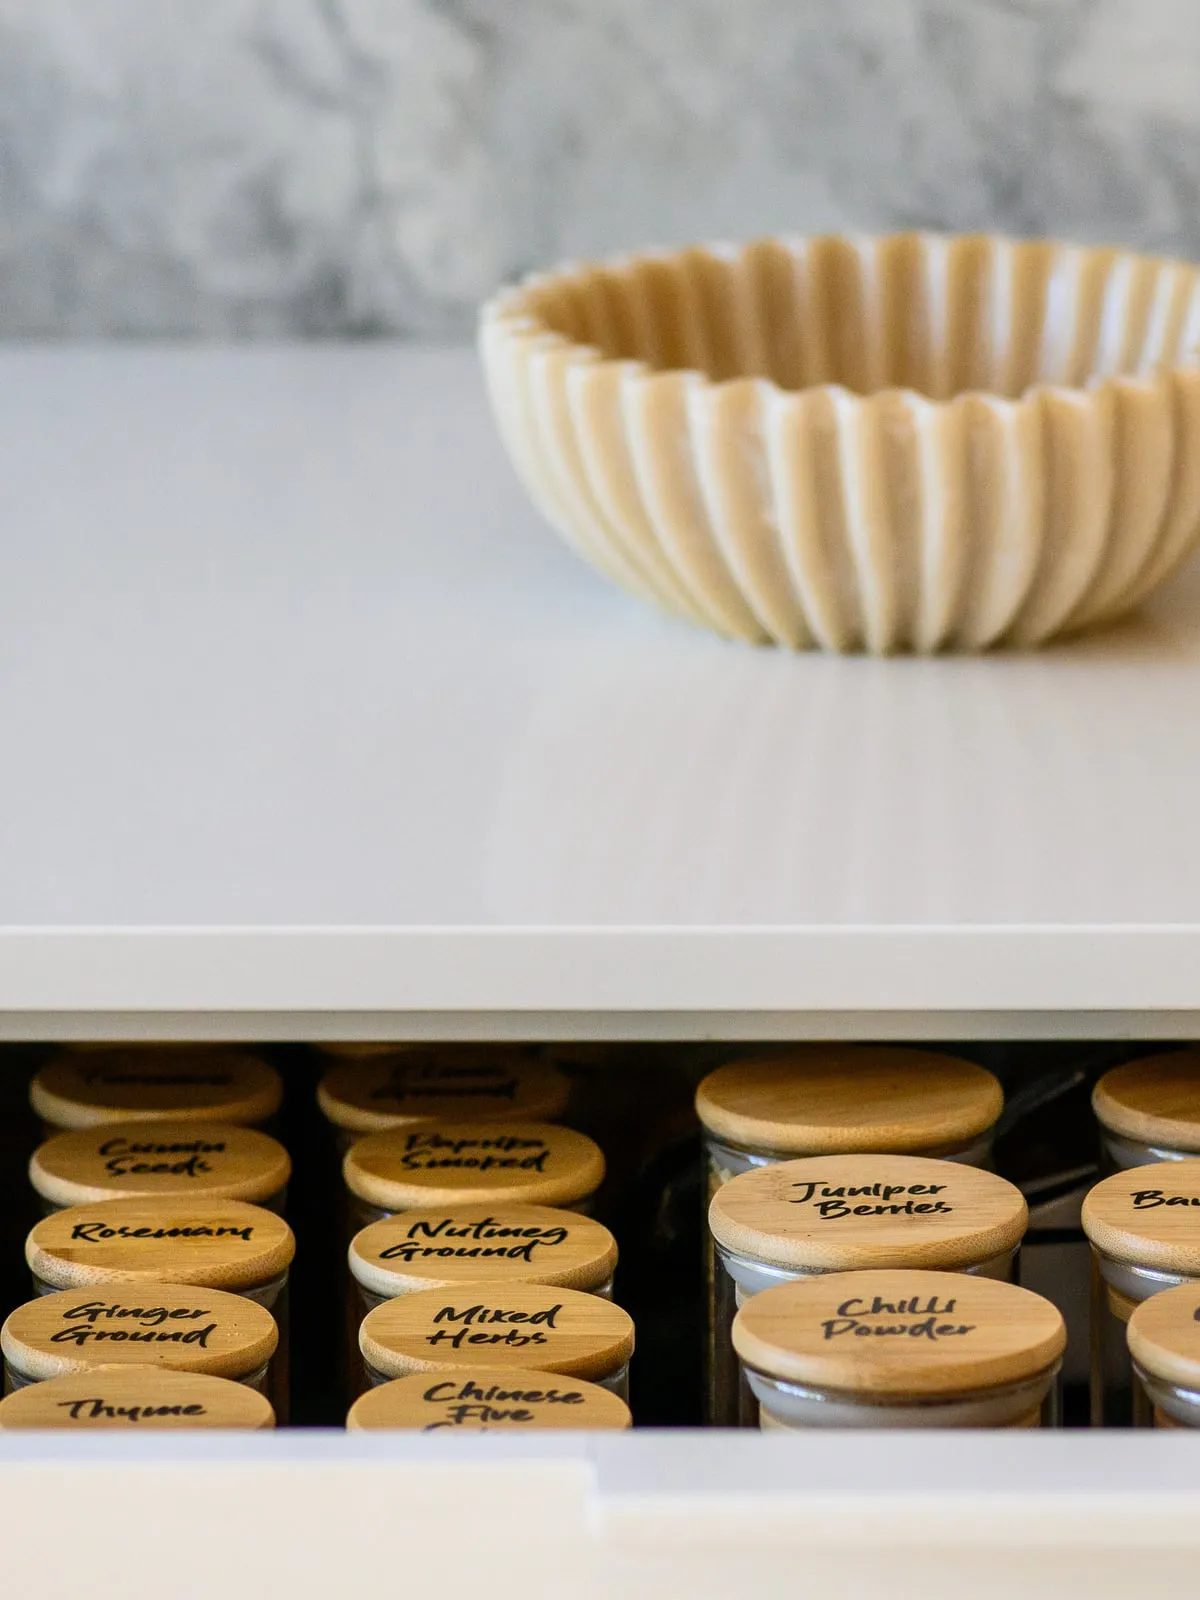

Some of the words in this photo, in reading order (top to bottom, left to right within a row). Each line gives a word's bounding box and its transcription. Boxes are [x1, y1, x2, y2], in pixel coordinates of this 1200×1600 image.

[105, 1155, 212, 1177] Seeds
[401, 1150, 550, 1172] Smoked
[789, 1181, 948, 1204] Juniper
[813, 1200, 953, 1221] Berries
[71, 1222, 254, 1243] Rosemary
[407, 1217, 569, 1245] Nutmeg
[379, 1239, 541, 1263] Ground
[63, 1302, 212, 1327] Ginger
[433, 1304, 563, 1329] Mixed
[837, 1296, 957, 1318] Chilli
[51, 1324, 217, 1348] Ground
[426, 1328, 547, 1349] Herbs
[821, 1317, 978, 1341] Powder
[423, 1381, 585, 1404] Chinese
[58, 1399, 207, 1422] Thyme
[446, 1404, 535, 1424] Five
